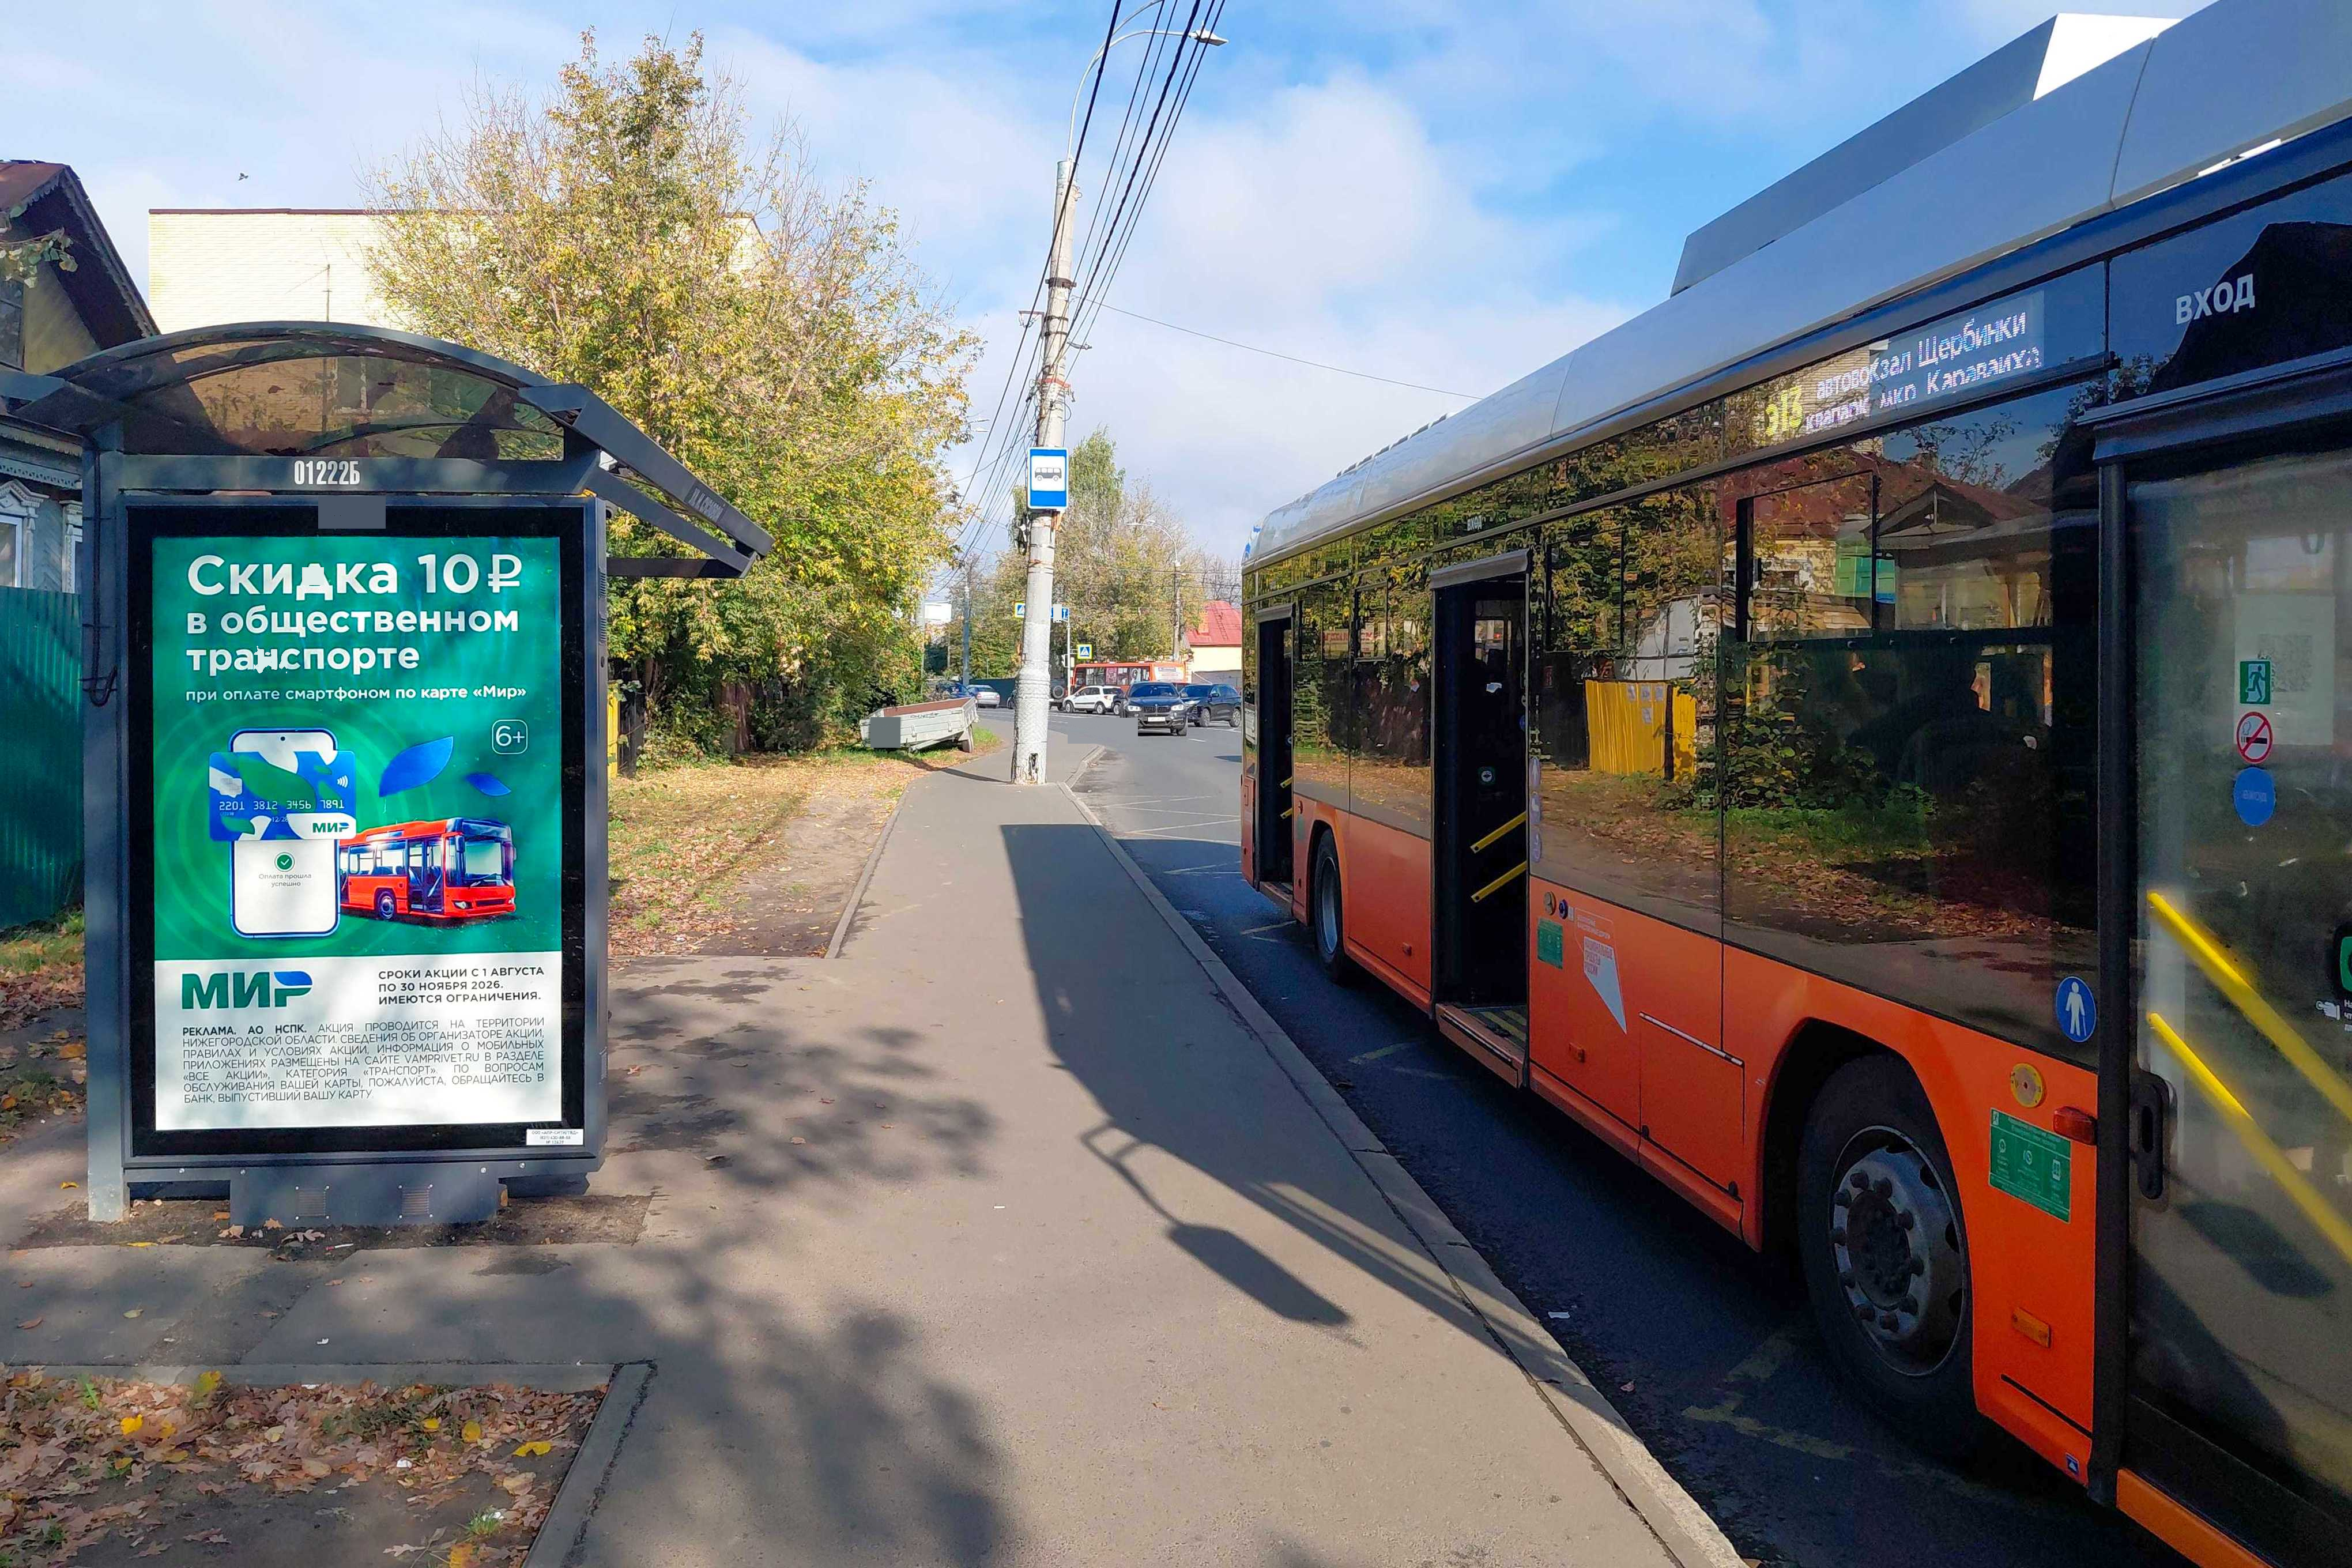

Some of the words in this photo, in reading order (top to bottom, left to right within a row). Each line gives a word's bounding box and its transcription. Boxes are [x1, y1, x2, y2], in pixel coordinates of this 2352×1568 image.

[2176, 273, 2255, 325] ВХОД
[1817, 350, 1911, 399] автовокзал
[1918, 312, 2026, 367] Щербинки
[294, 460, 360, 485] 01222Б
[1467, 515, 1482, 531] ВХОД
[187, 612, 208, 634] в
[220, 604, 518, 638] общественном
[186, 691, 217, 702] при
[223, 689, 280, 701] оплате
[285, 686, 390, 701] смартфоном
[396, 688, 416, 698] по
[421, 687, 468, 699] карте
[473, 685, 526, 700] «Мир»
[496, 725, 525, 747] 6+
[219, 801, 245, 811] 2201
[254, 800, 278, 810] 3812
[287, 800, 311, 809] 3456
[321, 800, 345, 809] 7891
[312, 822, 349, 833] МИР
[379, 970, 421, 979] СРОКИ
[425, 968, 467, 979] АКЦИИ
[472, 968, 479, 977] С
[483, 968, 487, 977] 1
[491, 967, 544, 977] АВГУСТА
[182, 970, 313, 1009] МИР
[379, 983, 396, 992] ПО
[401, 982, 414, 992] 30
[419, 982, 467, 991] НОЯБРЯ
[471, 981, 503, 990] 2026.
[379, 994, 442, 1005] ИМЕЮТСЯ
[446, 992, 541, 1003] ОГРАНИЧЕНИЯ.
[183, 1026, 236, 1036] РЕКЛАМА.
[248, 1026, 263, 1034] АО
[276, 1024, 307, 1034] НСПК.
[318, 1023, 353, 1034] АКЦИЯ
[365, 1020, 439, 1032] ПРОВОДИТСЯ
[450, 1020, 465, 1028] НА
[476, 1017, 544, 1028] ТЕРРИТОРИИ
[183, 1035, 281, 1047] НИЖЕГОРОДСКОЙ
[285, 1035, 337, 1045] ОБЛАСТИ.
[340, 1032, 398, 1045] СВЕДЕНИЯ
[401, 1032, 416, 1041] ОБ
[419, 1030, 503, 1041] ОРГАНИЗАТОРЕ
[183, 1048, 241, 1059] ПРАВИЛАХ
[249, 1047, 257, 1056] И
[265, 1047, 322, 1057] УСЛОВИЯХ
[377, 1042, 453, 1054] ИНФОРМАЦИЯ
[461, 1042, 469, 1051] О
[477, 1039, 544, 1050] МОБИЛЬНЫХ
[183, 1059, 266, 1070] ПРИЛОЖЕНИЯХ
[272, 1058, 340, 1069] РАЗМЕЩЕНЫ
[345, 1057, 360, 1065] НА
[364, 1054, 400, 1065] САЙТЕ
[405, 1053, 480, 1064] VAMPRIVET.RU
[485, 1052, 491, 1061] В
[496, 1051, 544, 1061] РАЗДЕЛЕ
[183, 1072, 209, 1081] «ВСЕ
[286, 1068, 348, 1078] КАТЕГОРИЯ
[454, 1064, 469, 1073] ПО
[485, 1062, 544, 1073] ВОПРОСАМ
[183, 1081, 274, 1092] ОБСЛУЖИВАНИЯ
[281, 1079, 319, 1090] ВАШЕЙ
[325, 1078, 363, 1089] КАРТЫ,
[452, 1073, 532, 1085] ОБРАЩАЙТЕСЬ
[537, 1073, 544, 1082] В
[184, 1094, 215, 1103] БАНК,
[218, 1091, 301, 1102] ВЫПУСТИВШИЙ
[304, 1091, 337, 1100] ВАШУ
